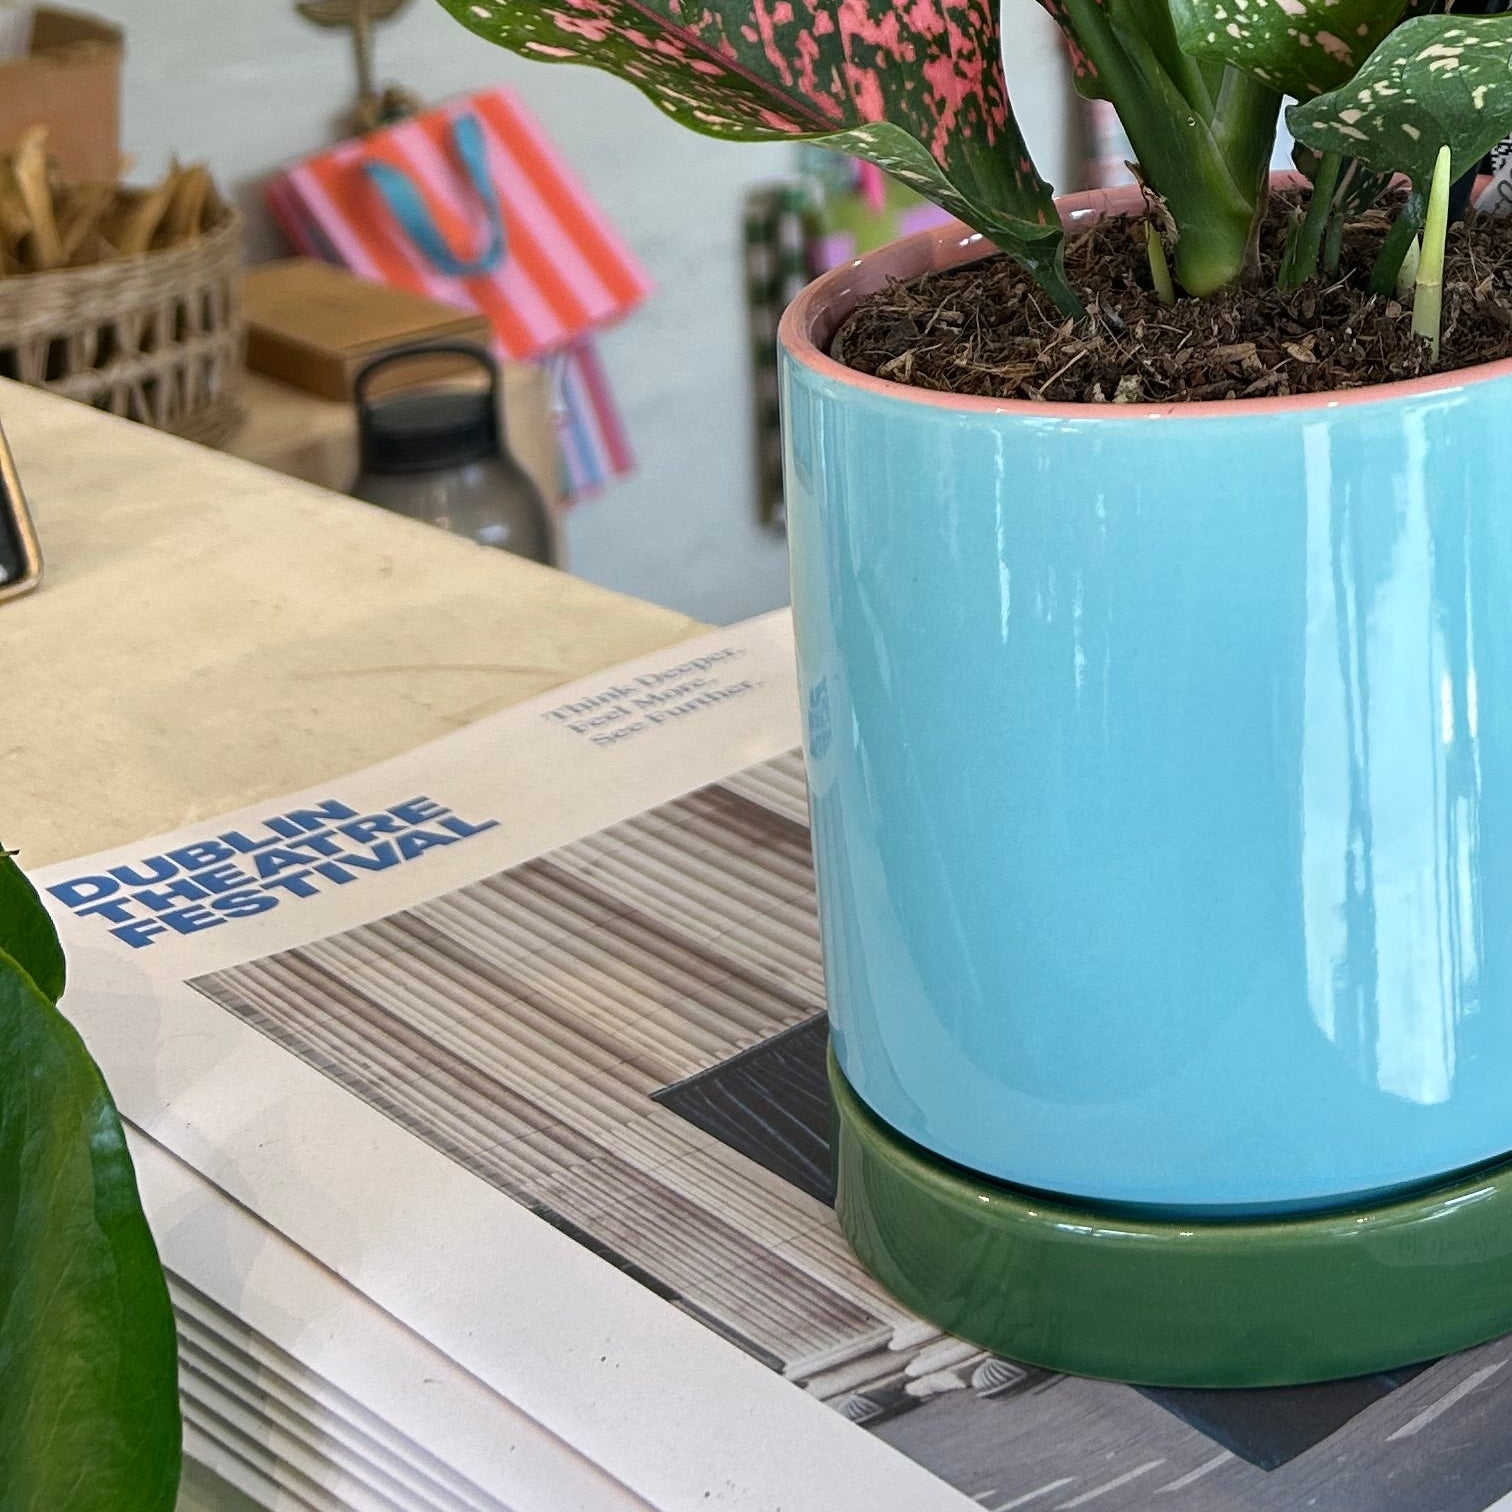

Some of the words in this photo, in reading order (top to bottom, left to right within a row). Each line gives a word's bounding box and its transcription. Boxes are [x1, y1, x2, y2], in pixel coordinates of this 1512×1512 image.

[541, 685, 637, 720] Think
[634, 646, 746, 687] Deeper.
[567, 704, 632, 734] Feel
[631, 677, 719, 709] More.
[590, 721, 645, 745] See
[645, 679, 765, 725] Further.
[44, 798, 360, 909] DUBLIN
[74, 795, 453, 924] THEATRE
[108, 815, 501, 949] FESTIVAL
